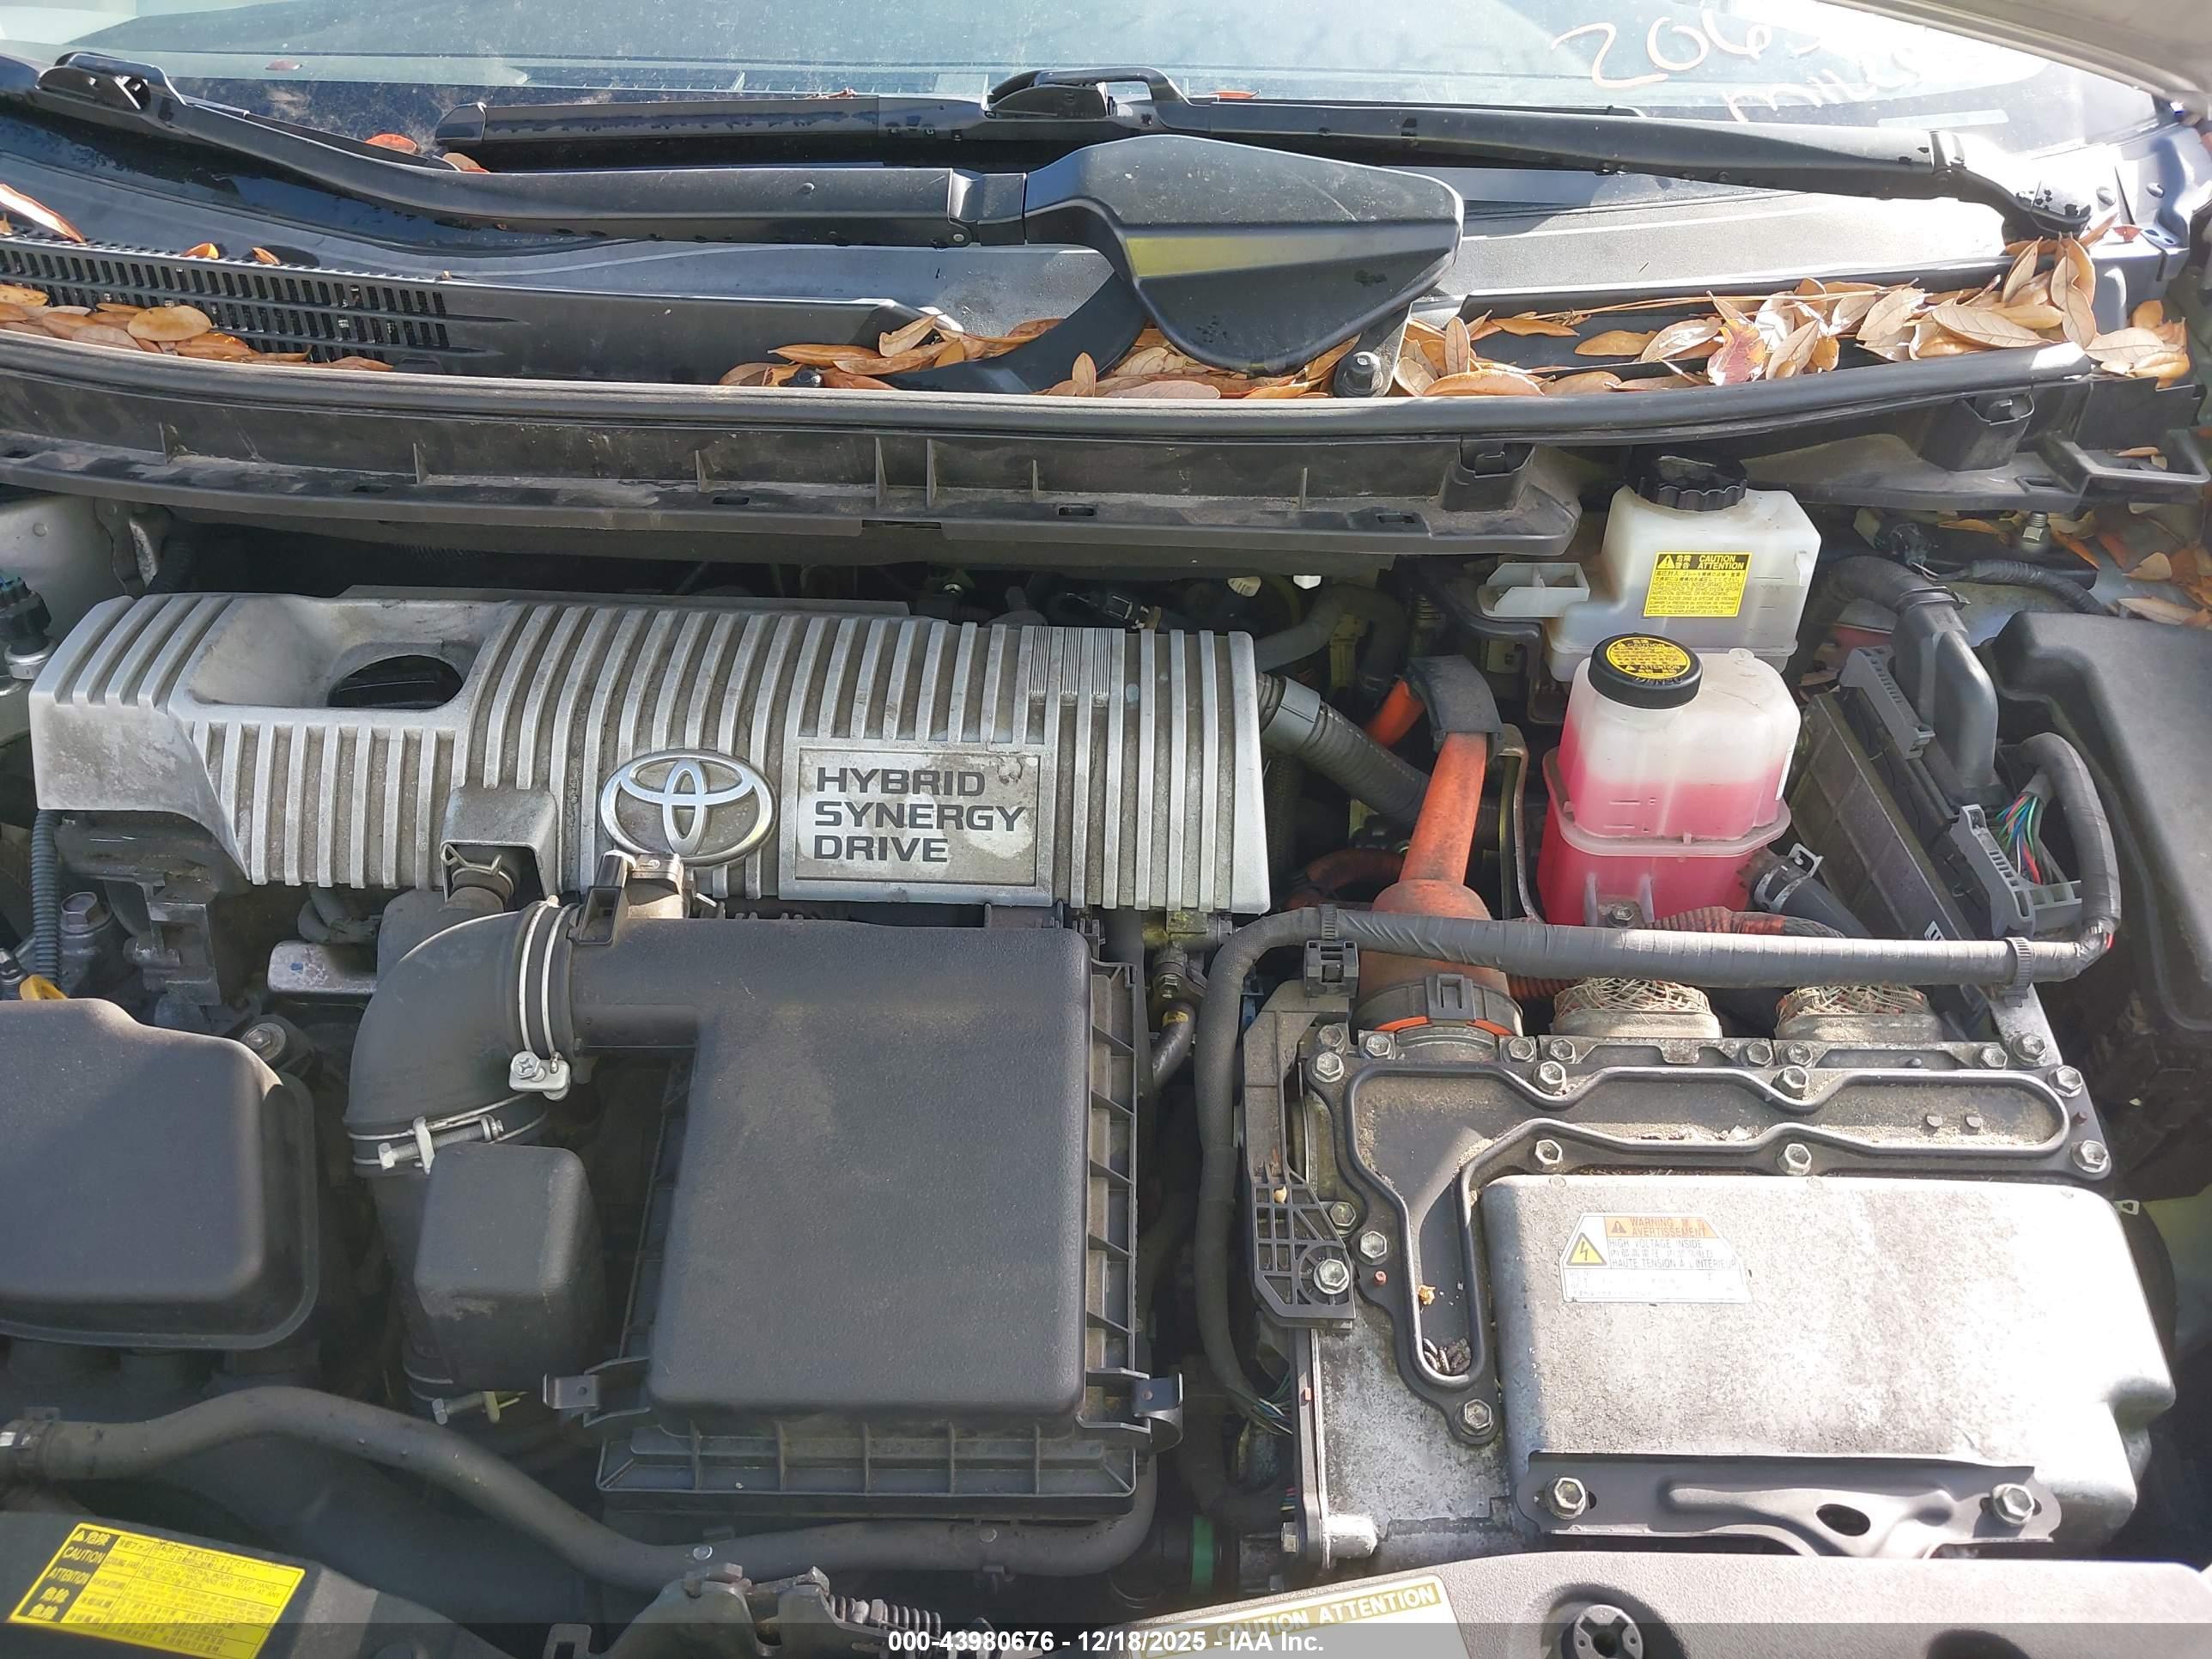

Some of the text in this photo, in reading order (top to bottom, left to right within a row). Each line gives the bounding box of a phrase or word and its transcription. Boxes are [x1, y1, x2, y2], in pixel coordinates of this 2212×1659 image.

[817, 767, 985, 797] HYBRID
[815, 800, 1025, 831] SYNERGY
[814, 835, 949, 862] DRIVE
[1630, 1217, 1674, 1227] WARNING
[1632, 1228, 1706, 1237] AVERTISSEMENT
[1609, 1239, 1629, 1248] HIGH
[1613, 1259, 1640, 1267] HAUTE
[1642, 1259, 1675, 1267] TENSION
[62, 1546, 106, 1564] CAUTION
[46, 1567, 92, 1585] ATTENTION
[1217, 1587, 1437, 1643] CAUTION ATTENTION
